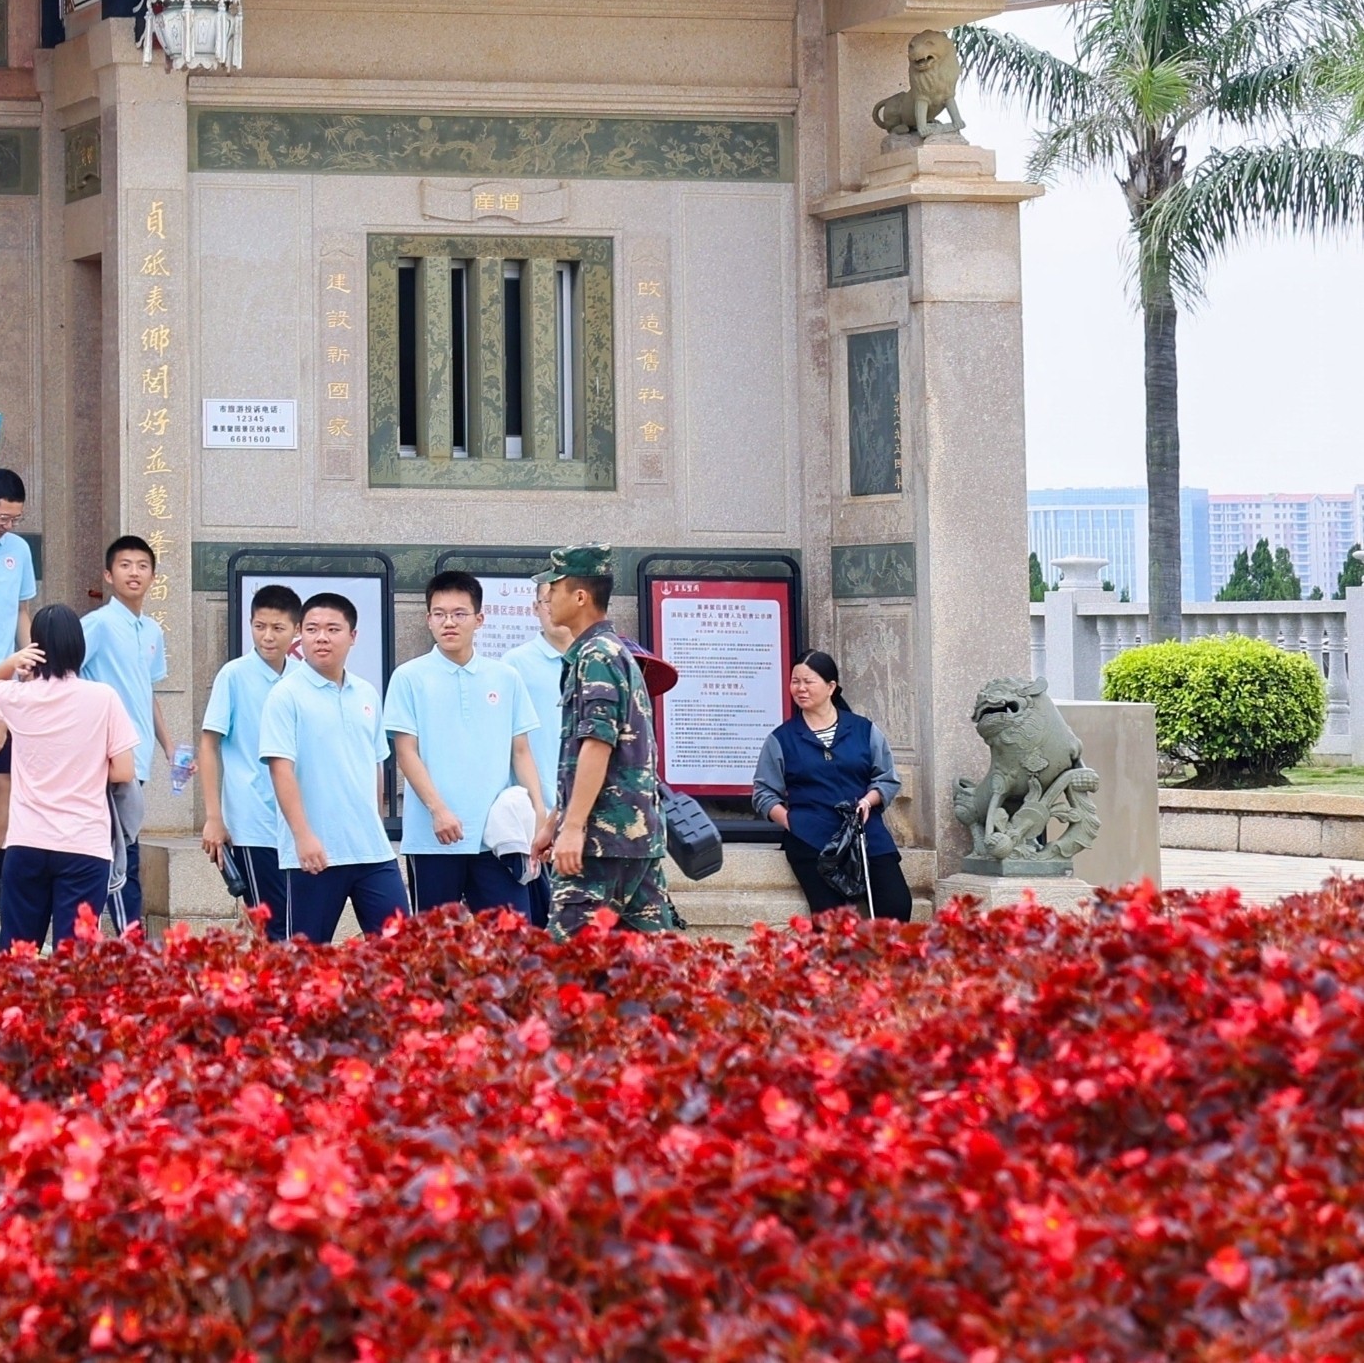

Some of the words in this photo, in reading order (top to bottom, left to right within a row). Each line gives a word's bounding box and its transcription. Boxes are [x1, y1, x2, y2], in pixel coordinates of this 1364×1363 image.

[326, 273, 353, 438] 建設新國家
[636, 281, 666, 443] 改造舊社會
[230, 435, 271, 443] 6681600
[237, 415, 264, 423] 12345
